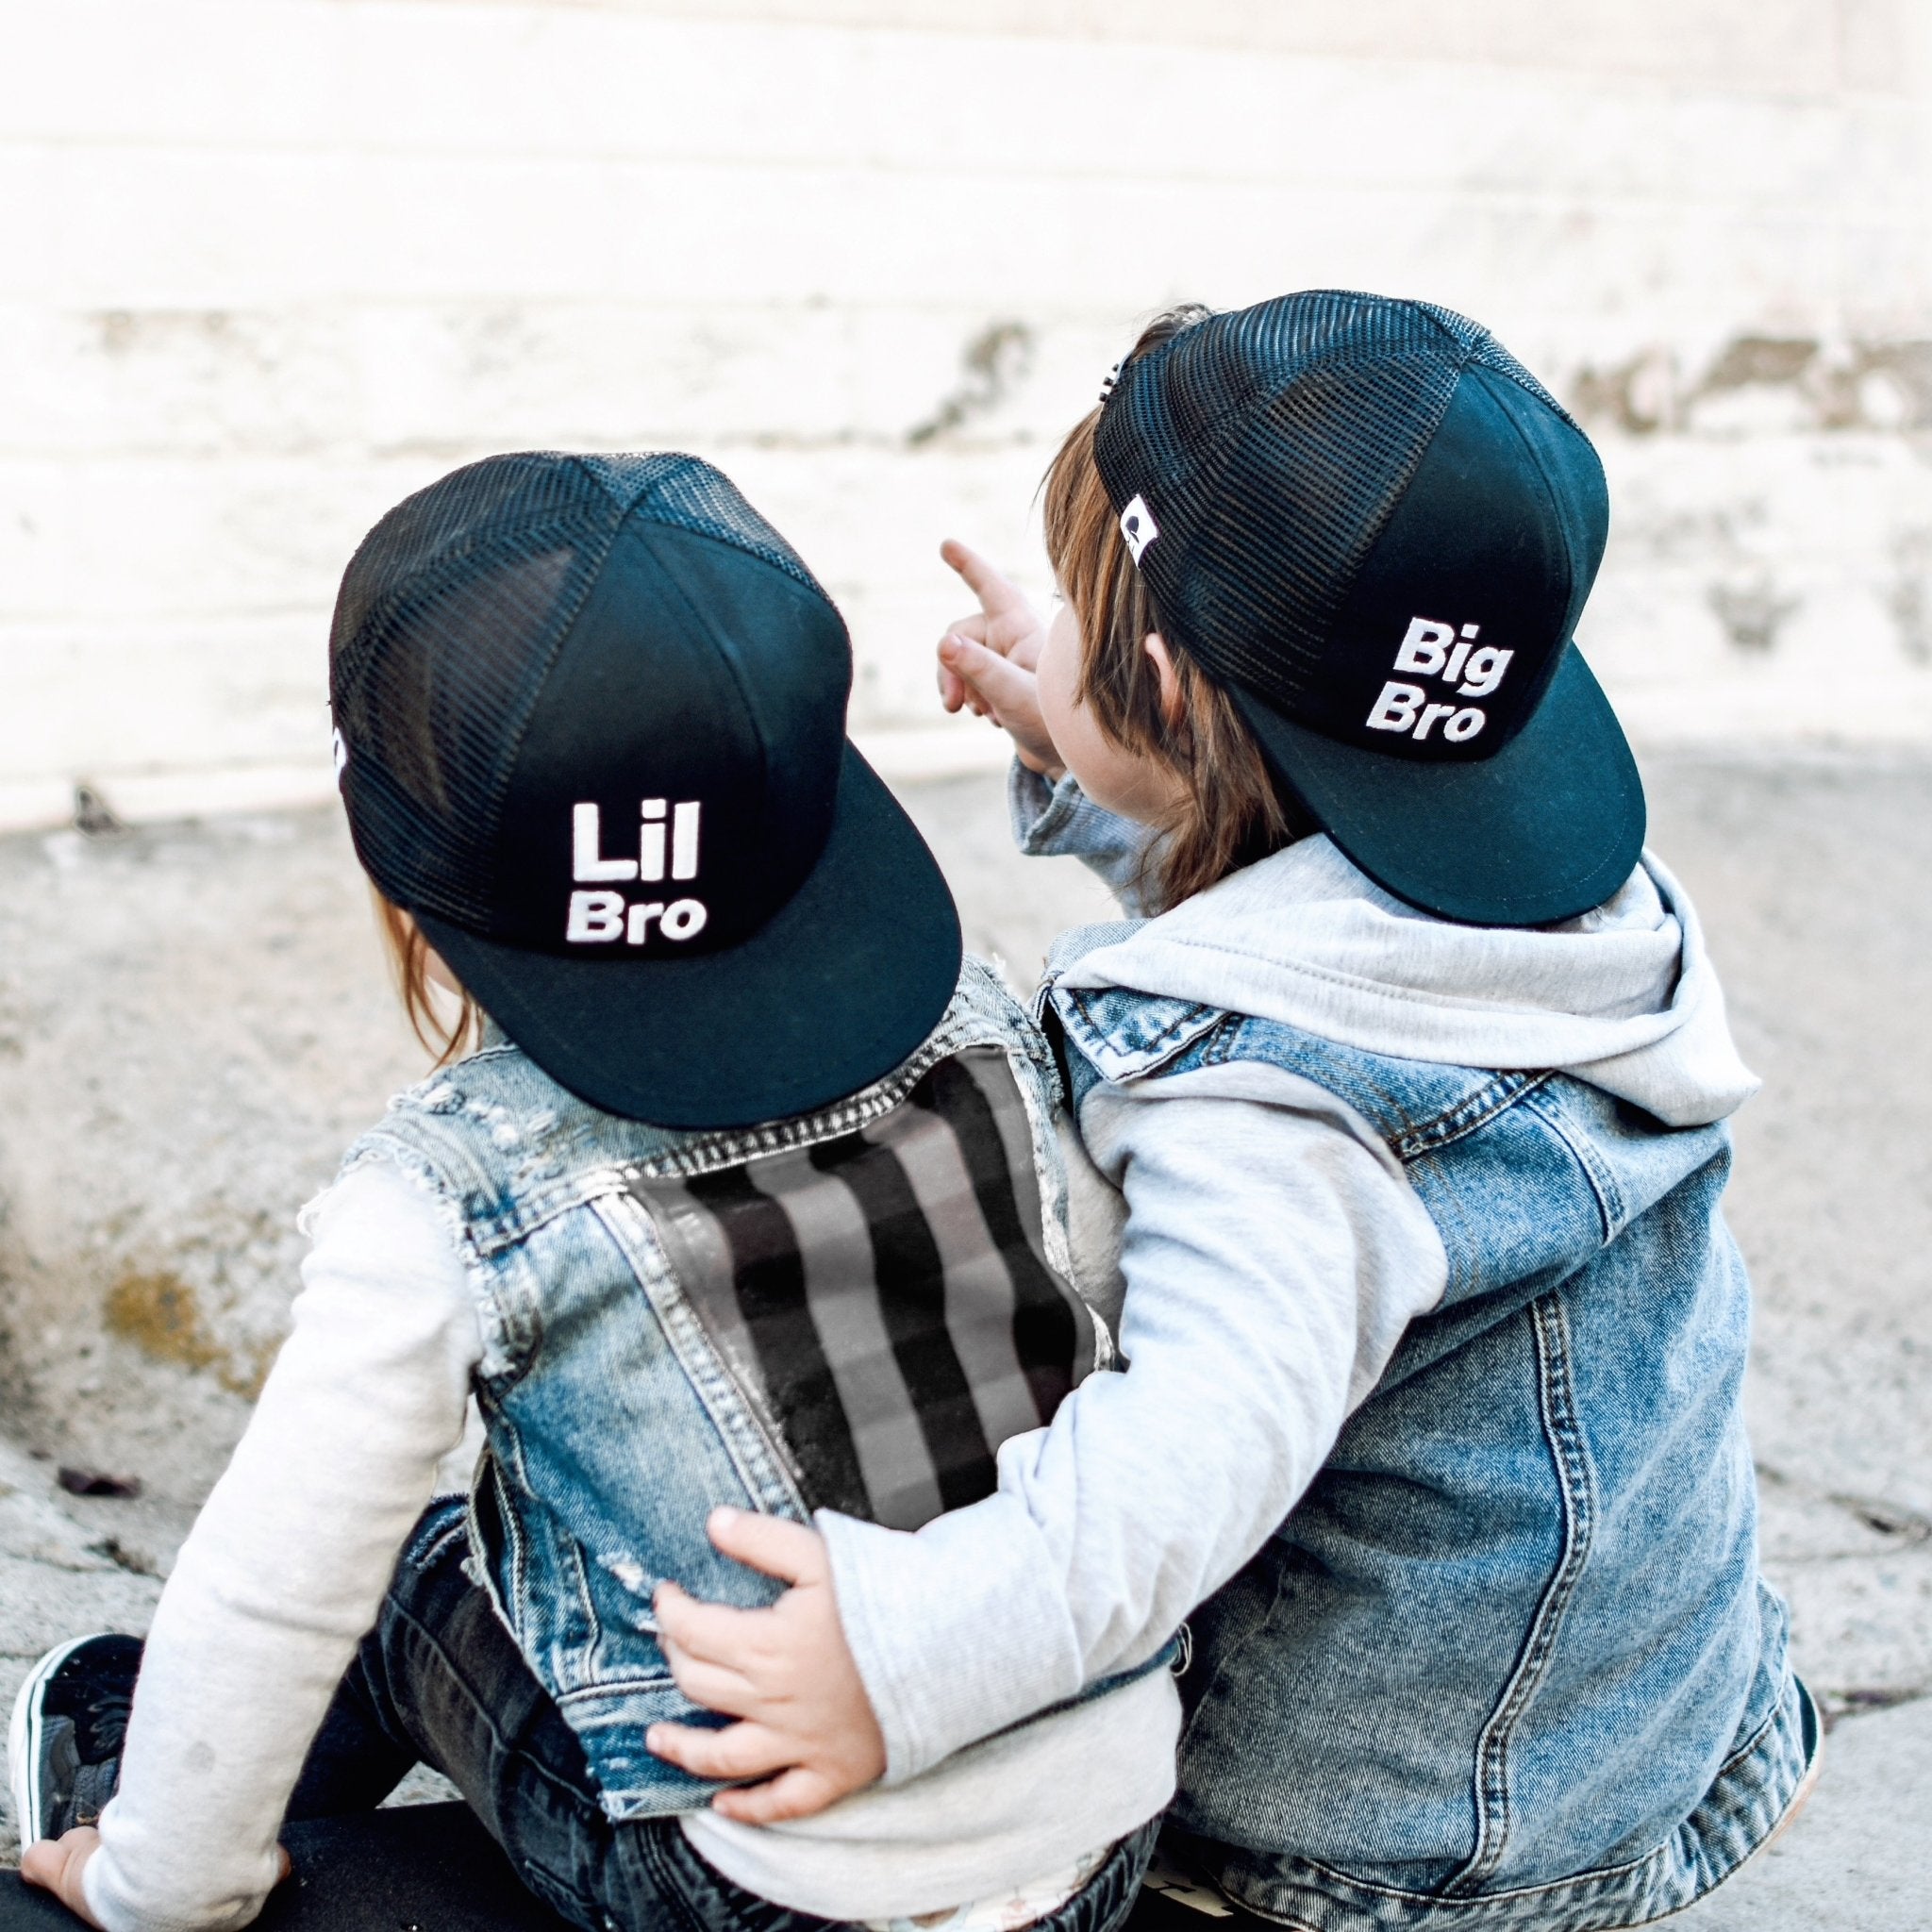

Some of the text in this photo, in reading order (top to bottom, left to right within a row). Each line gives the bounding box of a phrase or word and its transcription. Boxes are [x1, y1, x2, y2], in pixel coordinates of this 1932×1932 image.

[1393, 616, 1515, 697] Big
[1365, 680, 1487, 742] Bro
[573, 798, 701, 882] Lil
[566, 890, 708, 945] Bro
